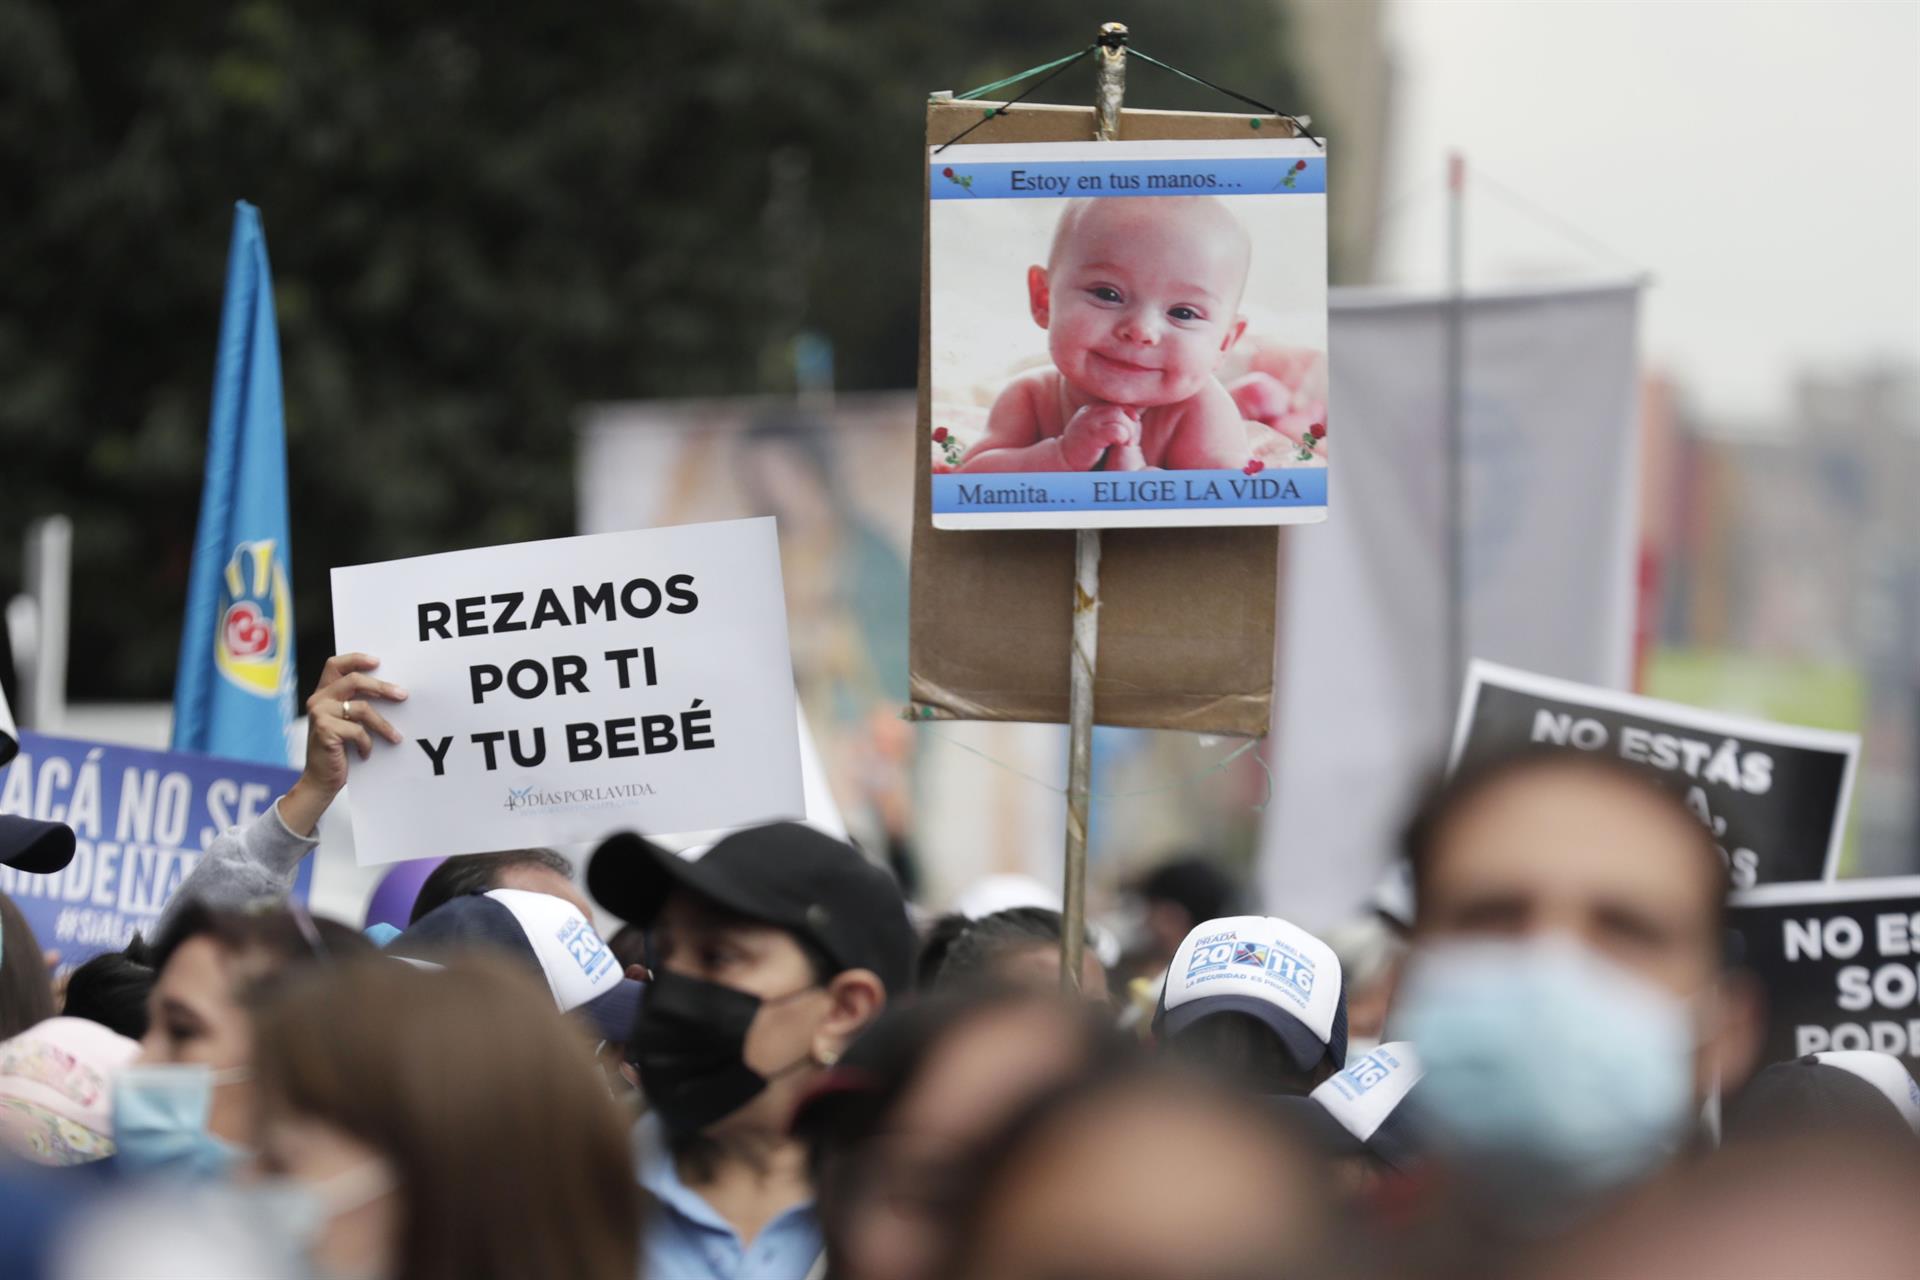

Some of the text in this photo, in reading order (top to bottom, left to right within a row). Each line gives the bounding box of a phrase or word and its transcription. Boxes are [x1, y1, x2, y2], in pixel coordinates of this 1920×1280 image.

[1010, 169, 1070, 195] Estoy
[1077, 176, 1104, 190] en
[1110, 172, 1141, 190] tus
[1092, 479, 1177, 504] ELIGE
[1184, 478, 1223, 502] LA
[1229, 477, 1302, 500] VIDA
[416, 573, 700, 642] REZAMOS
[469, 646, 658, 704] POR TI
[416, 697, 716, 776] Y TU BEBÉ
[1530, 708, 1774, 795] NO ESTÁS
[114, 766, 193, 848] NO
[1782, 915, 1864, 963] NO
[1189, 942, 1232, 971] 20
[1270, 948, 1314, 994] 116
[1836, 962, 1920, 1012] SO
